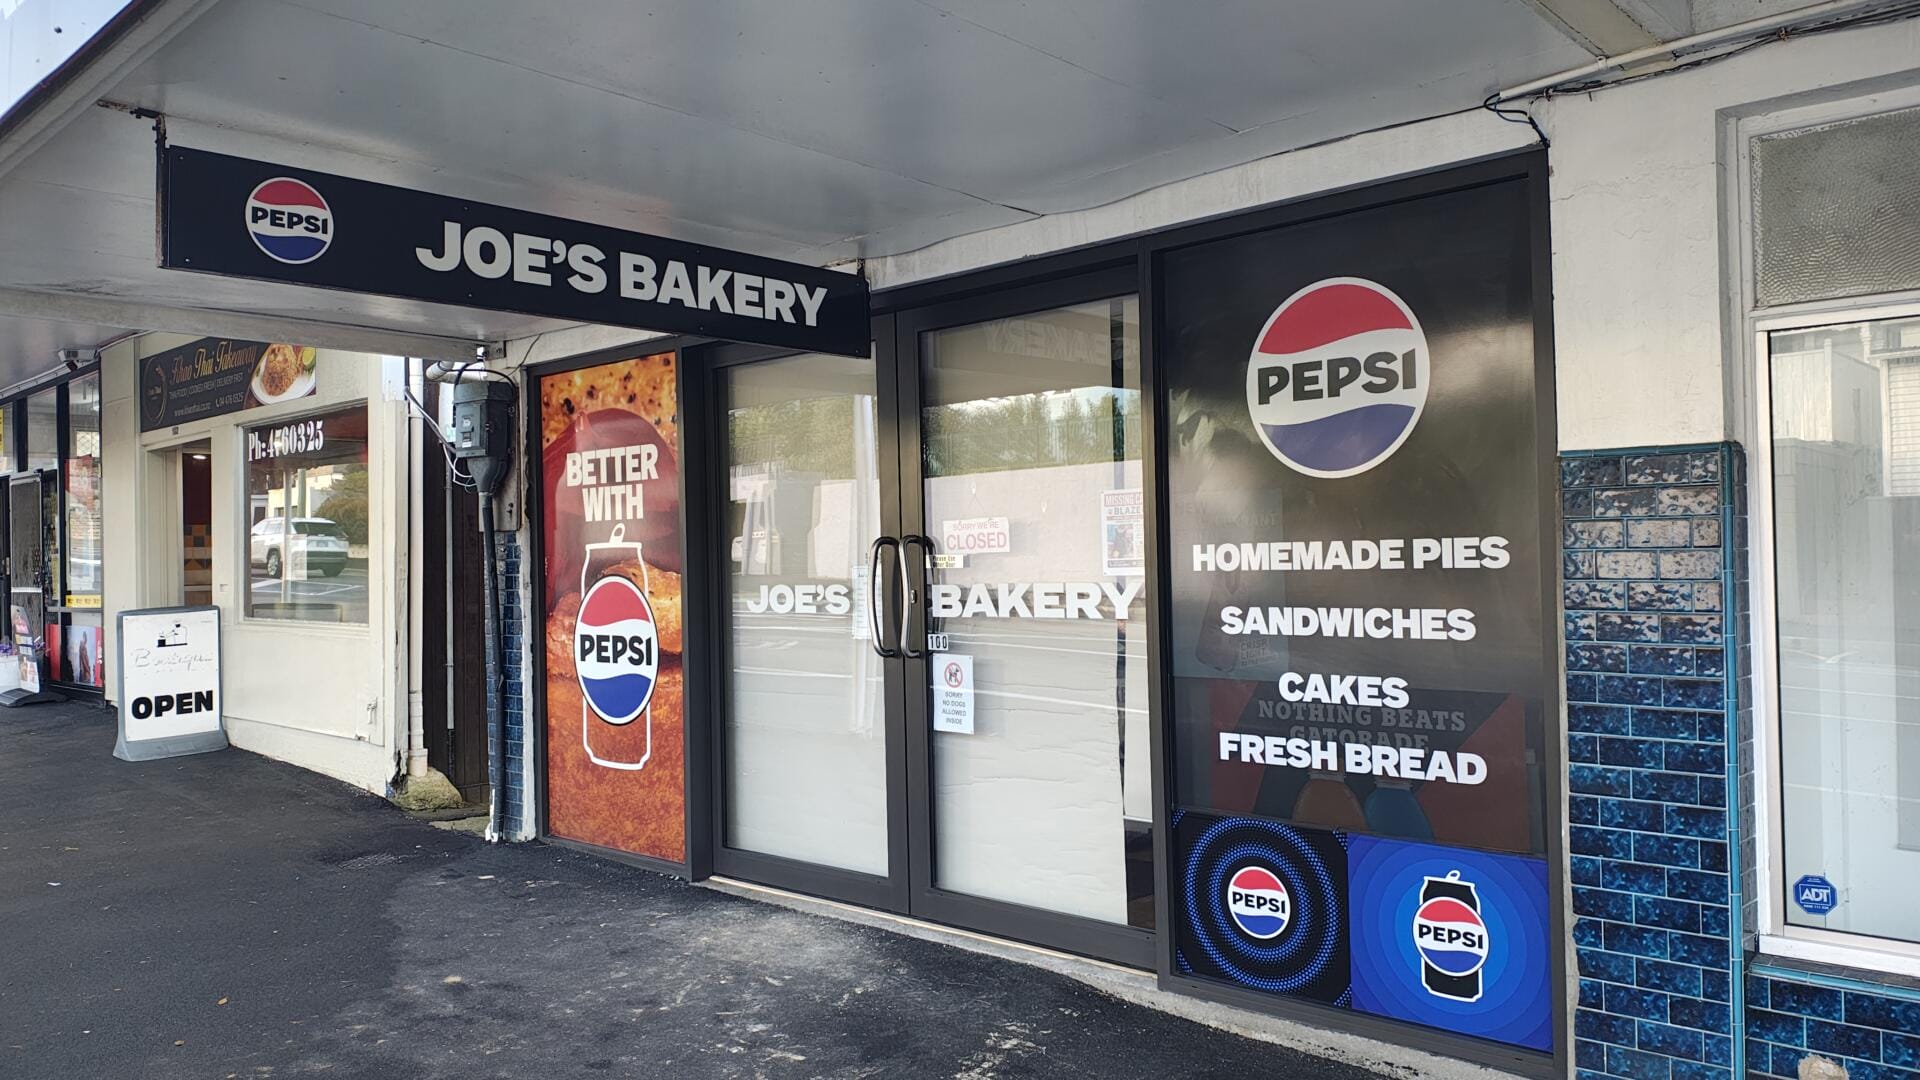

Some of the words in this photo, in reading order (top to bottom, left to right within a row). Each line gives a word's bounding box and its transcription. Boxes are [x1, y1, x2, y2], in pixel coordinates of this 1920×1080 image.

[250, 207, 329, 235] PEPSI
[415, 221, 608, 294] JOE'S
[620, 251, 828, 327] BAKERY
[193, 347, 214, 378] Thai
[215, 341, 257, 373] Takeaway
[1258, 348, 1416, 405] PEPSI
[566, 443, 659, 488] BETTER
[582, 483, 643, 522] WITH
[1105, 494, 1134, 505] MISSING
[1114, 506, 1141, 515] BLAZE
[946, 531, 1007, 550] CLOSED
[1192, 540, 1405, 572] HOMEMADE
[1412, 536, 1511, 569] PIES
[746, 583, 850, 615] JOE'S
[932, 582, 1144, 620] BAKERY
[1220, 606, 1477, 641] SANDWICHES
[580, 634, 652, 666] PEPSI
[930, 636, 947, 649] 100
[131, 690, 214, 720] OPEN
[951, 700, 966, 708] DOGS
[1278, 672, 1409, 709] CAKES
[941, 708, 967, 717] ALLOWED
[1258, 700, 1372, 726] NOTHING
[1381, 708, 1466, 732] BEATS
[1219, 732, 1338, 771] FRESH
[1344, 742, 1487, 785] BREAD
[1232, 890, 1286, 914] PEPSI
[1801, 888, 1830, 903] ADT
[1418, 924, 1484, 949] PEPSI
